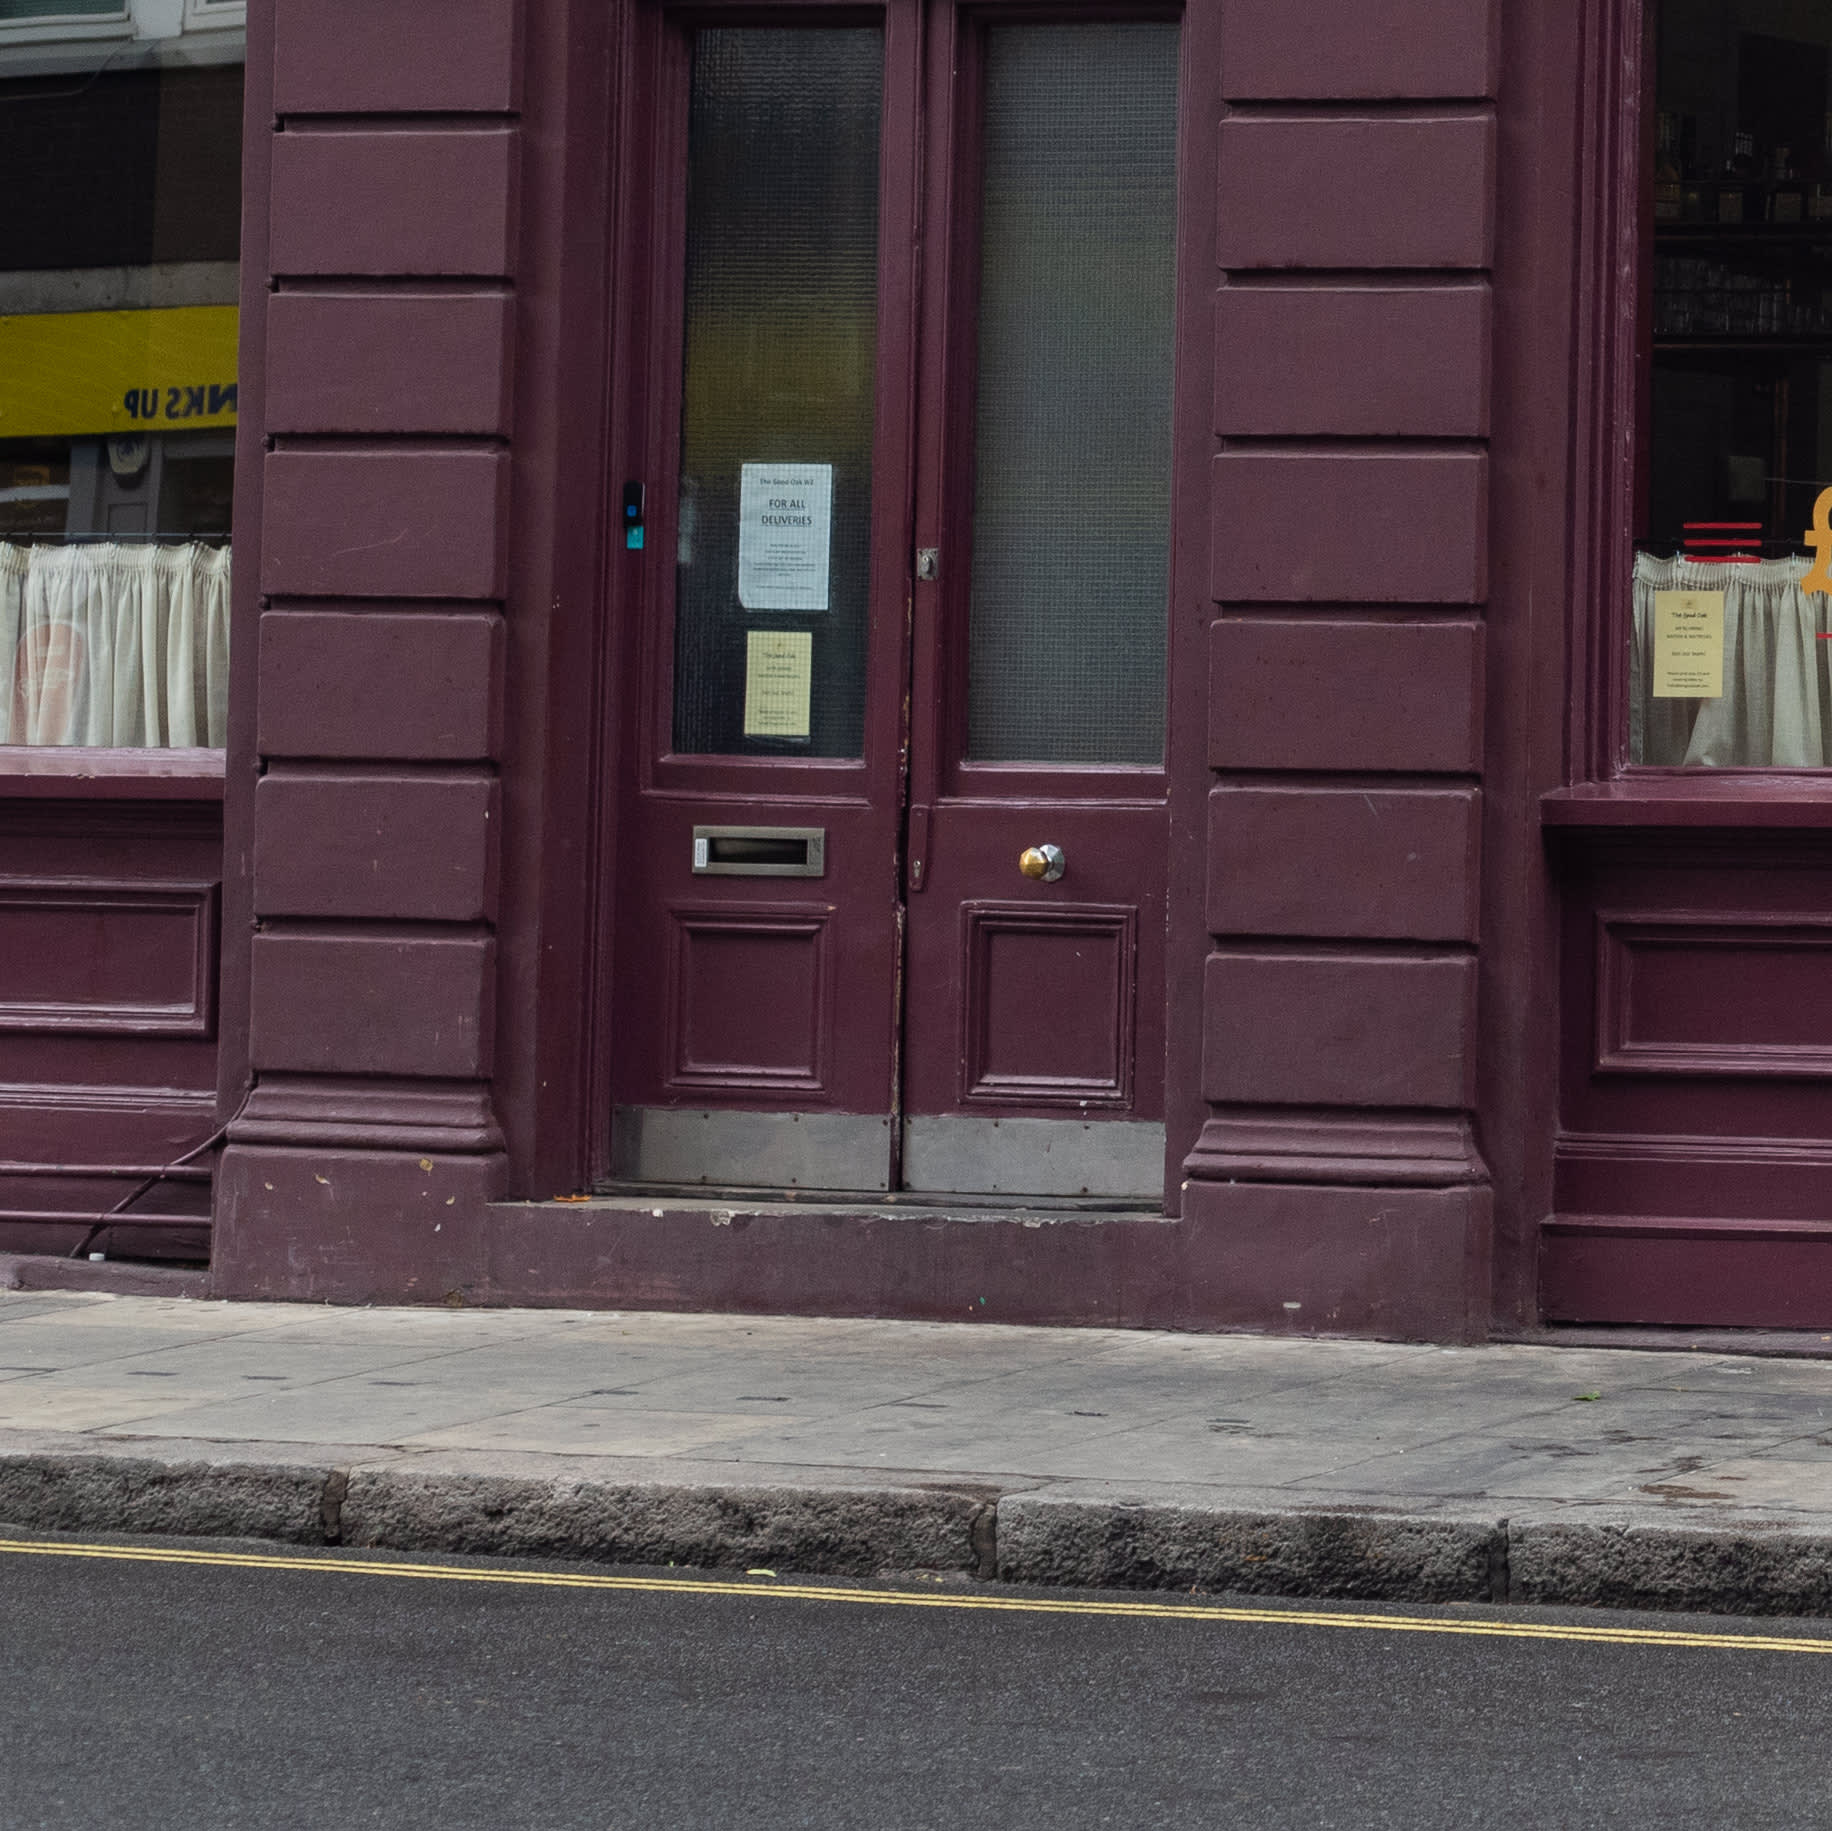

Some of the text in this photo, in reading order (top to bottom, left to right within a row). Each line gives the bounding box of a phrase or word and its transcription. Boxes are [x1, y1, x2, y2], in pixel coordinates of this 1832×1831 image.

[769, 499, 806, 509] FOR ALL
[761, 515, 812, 526] DELIVERIES
